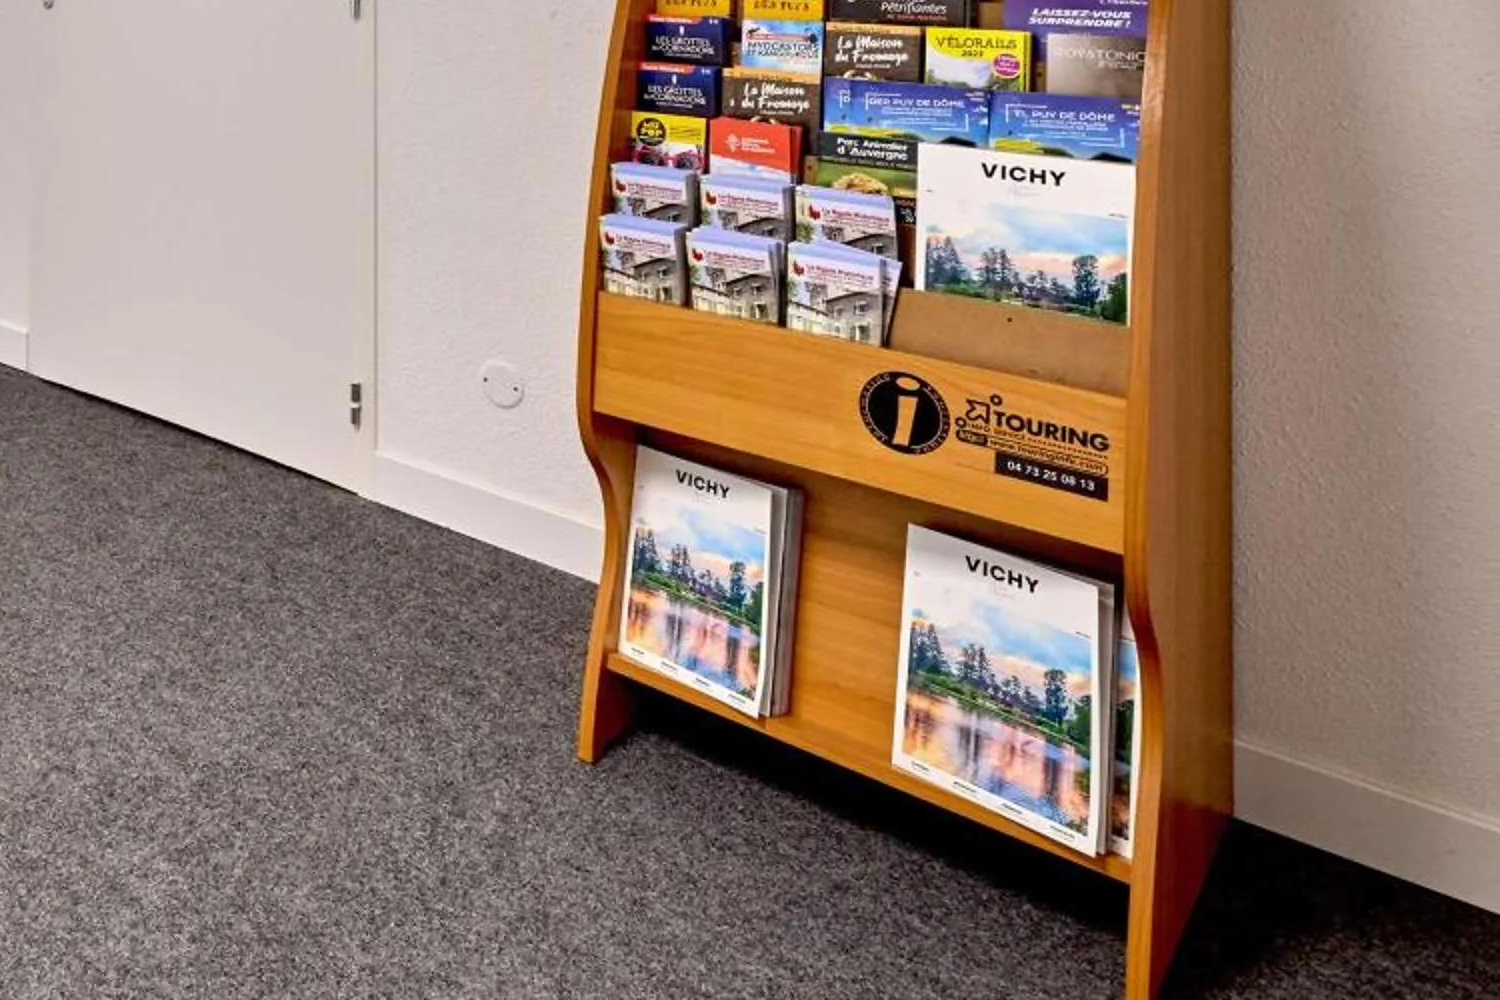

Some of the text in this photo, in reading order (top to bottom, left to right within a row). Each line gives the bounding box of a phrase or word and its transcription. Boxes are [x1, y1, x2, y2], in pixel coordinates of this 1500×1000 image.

[1031, 8, 1132, 19] LAISSEZ-VOUS
[838, 35, 903, 49] La Maison
[835, 50, 849, 62] du
[852, 50, 909, 67] Fromage
[862, 137, 908, 151] Animalier
[981, 162, 1067, 187] VICHY
[993, 411, 1109, 451] TOURING
[675, 469, 730, 499] VICHY
[1007, 460, 1022, 472] 04
[1025, 464, 1040, 477] 73
[1043, 469, 1057, 482] 25
[1079, 478, 1096, 491] 13
[965, 555, 1040, 594] VICHY
